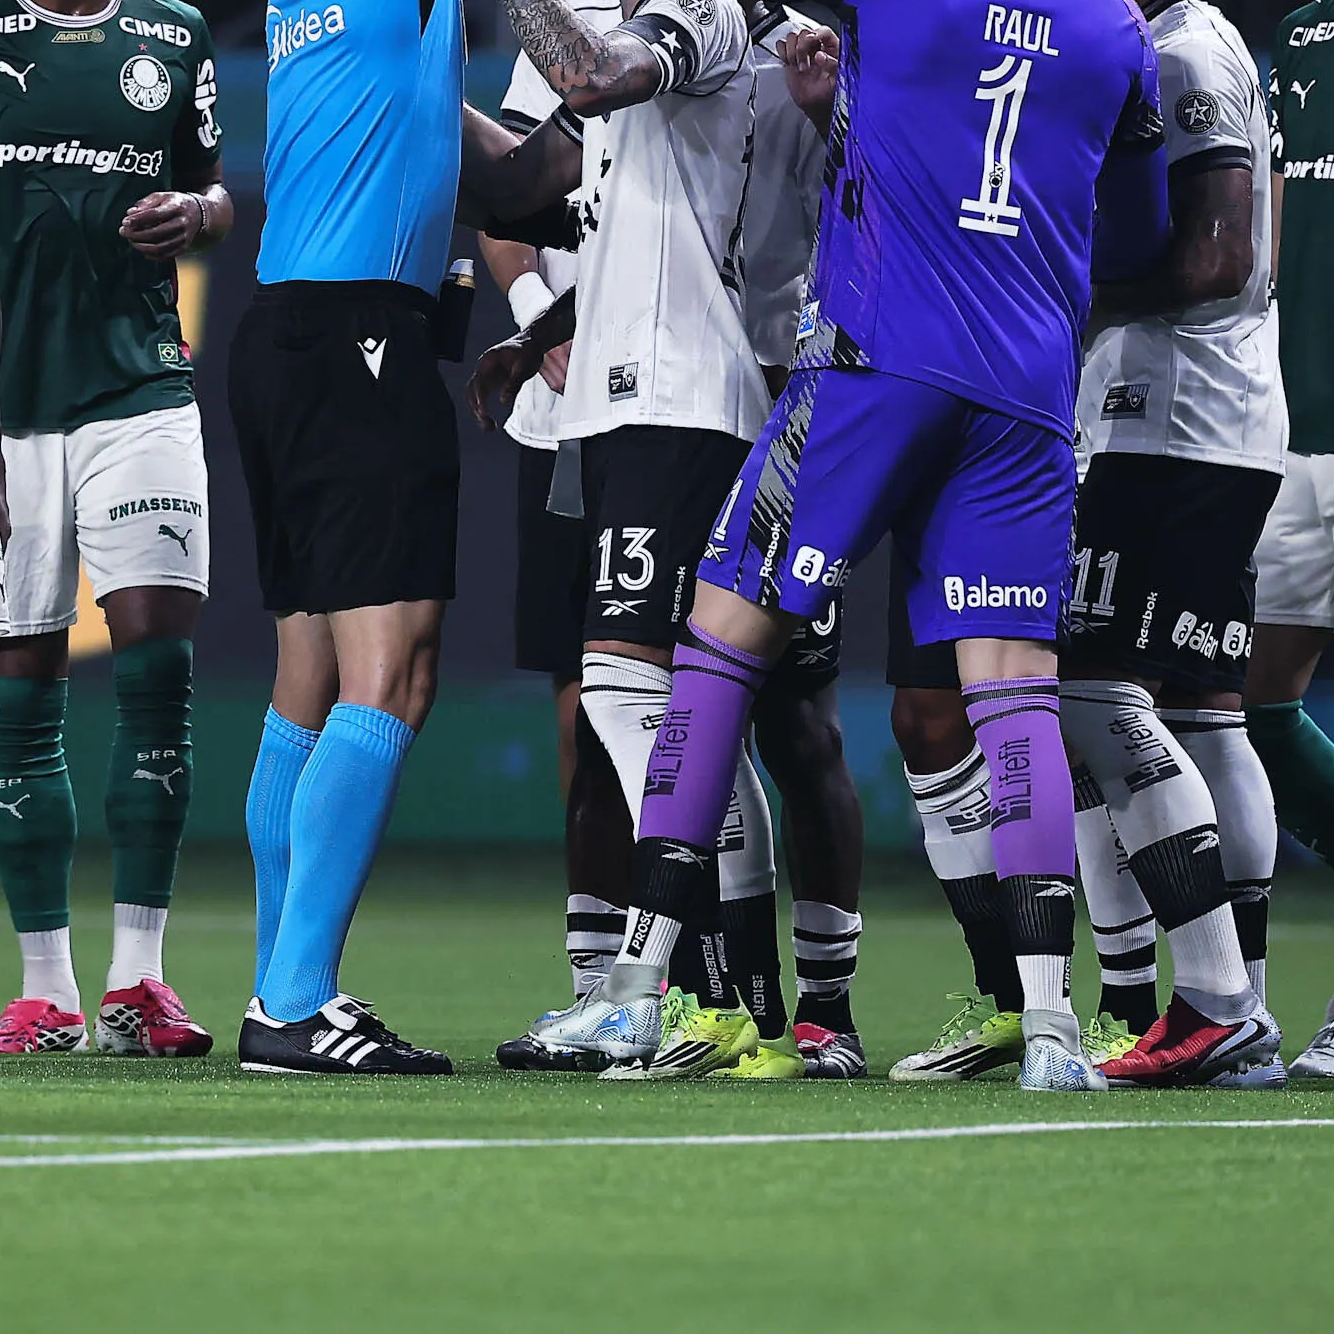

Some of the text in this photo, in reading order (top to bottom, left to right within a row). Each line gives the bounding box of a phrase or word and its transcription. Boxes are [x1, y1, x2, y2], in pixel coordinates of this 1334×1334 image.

[56, 31, 89, 43] AVANTI
[119, 17, 192, 48] CIMED
[983, 4, 1059, 57] RAUL
[958, 55, 1033, 237] 1
[109, 497, 202, 521] UNIASSELVI
[713, 478, 745, 541] 1
[595, 527, 657, 592] 13
[759, 521, 781, 578] Reebok
[671, 565, 687, 623] Reebok
[1069, 547, 1120, 617] 11
[1136, 591, 1158, 650] Reebok
